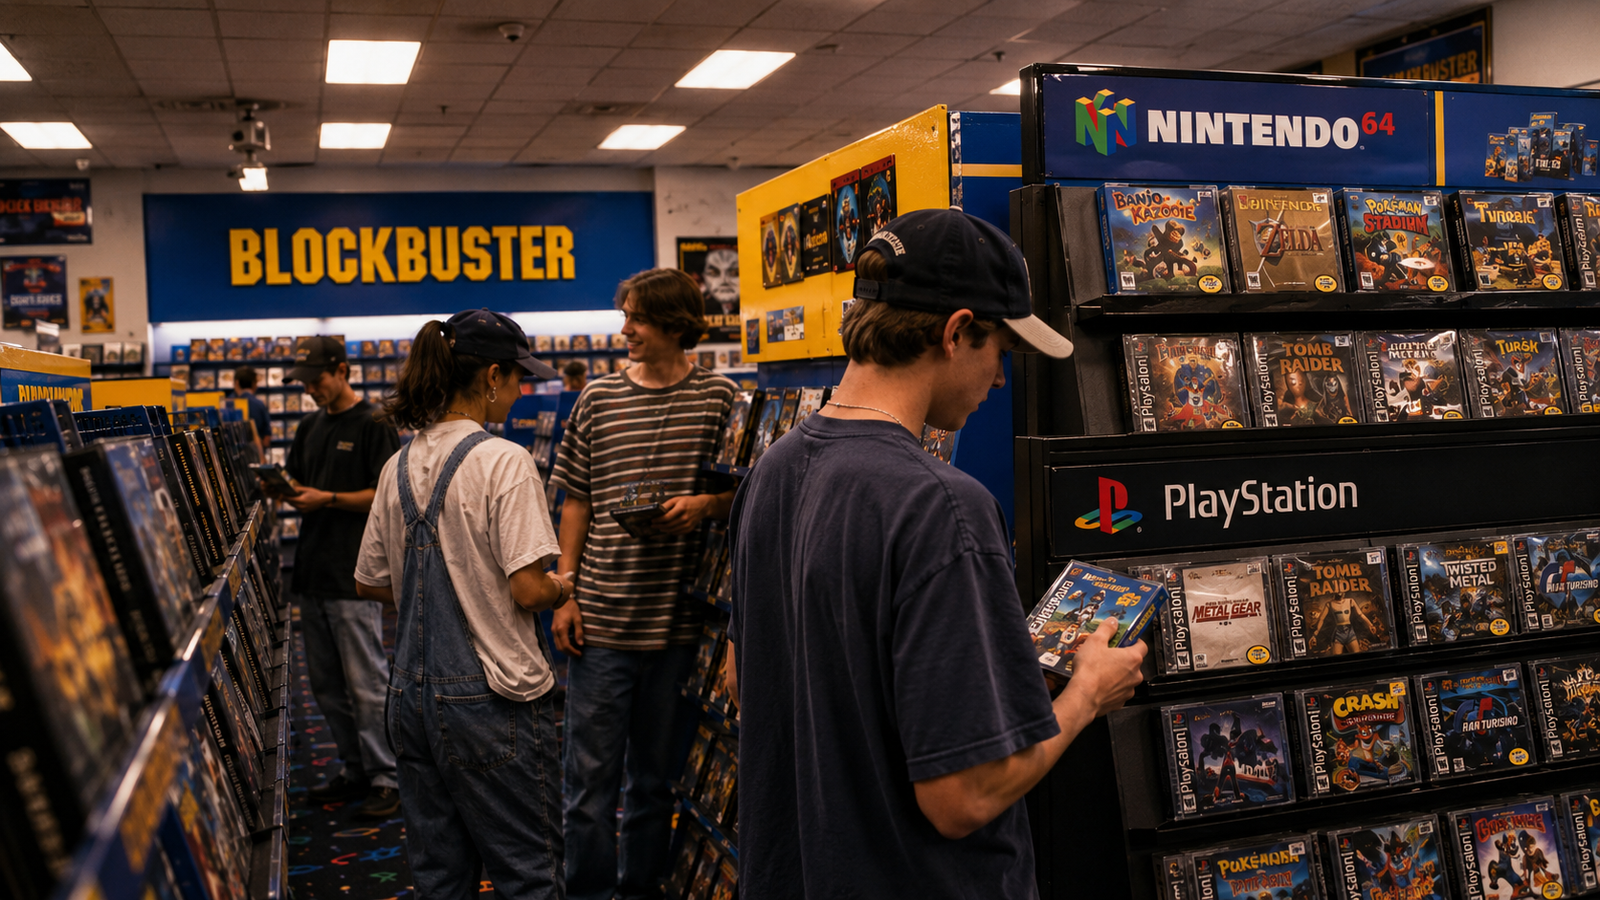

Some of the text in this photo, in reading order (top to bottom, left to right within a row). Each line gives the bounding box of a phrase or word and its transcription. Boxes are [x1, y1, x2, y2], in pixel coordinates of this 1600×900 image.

[1147, 109, 1396, 150] NINTENDO 64
[1255, 221, 1324, 257] ZELDA
[229, 225, 576, 286] BLOCKBUSTER
[1281, 342, 1334, 357] TOMB
[1279, 356, 1345, 375] RAIDER
[1164, 475, 1358, 529] PlayStation
[1311, 563, 1362, 580] TOMB
[1440, 557, 1497, 576] TWISTED
[1309, 577, 1373, 598] RAIDER
[1449, 573, 1495, 589] METAL
[1192, 604, 1230, 623] METAL
[1231, 601, 1262, 617] GEAR
[1333, 692, 1399, 718] CRASH
